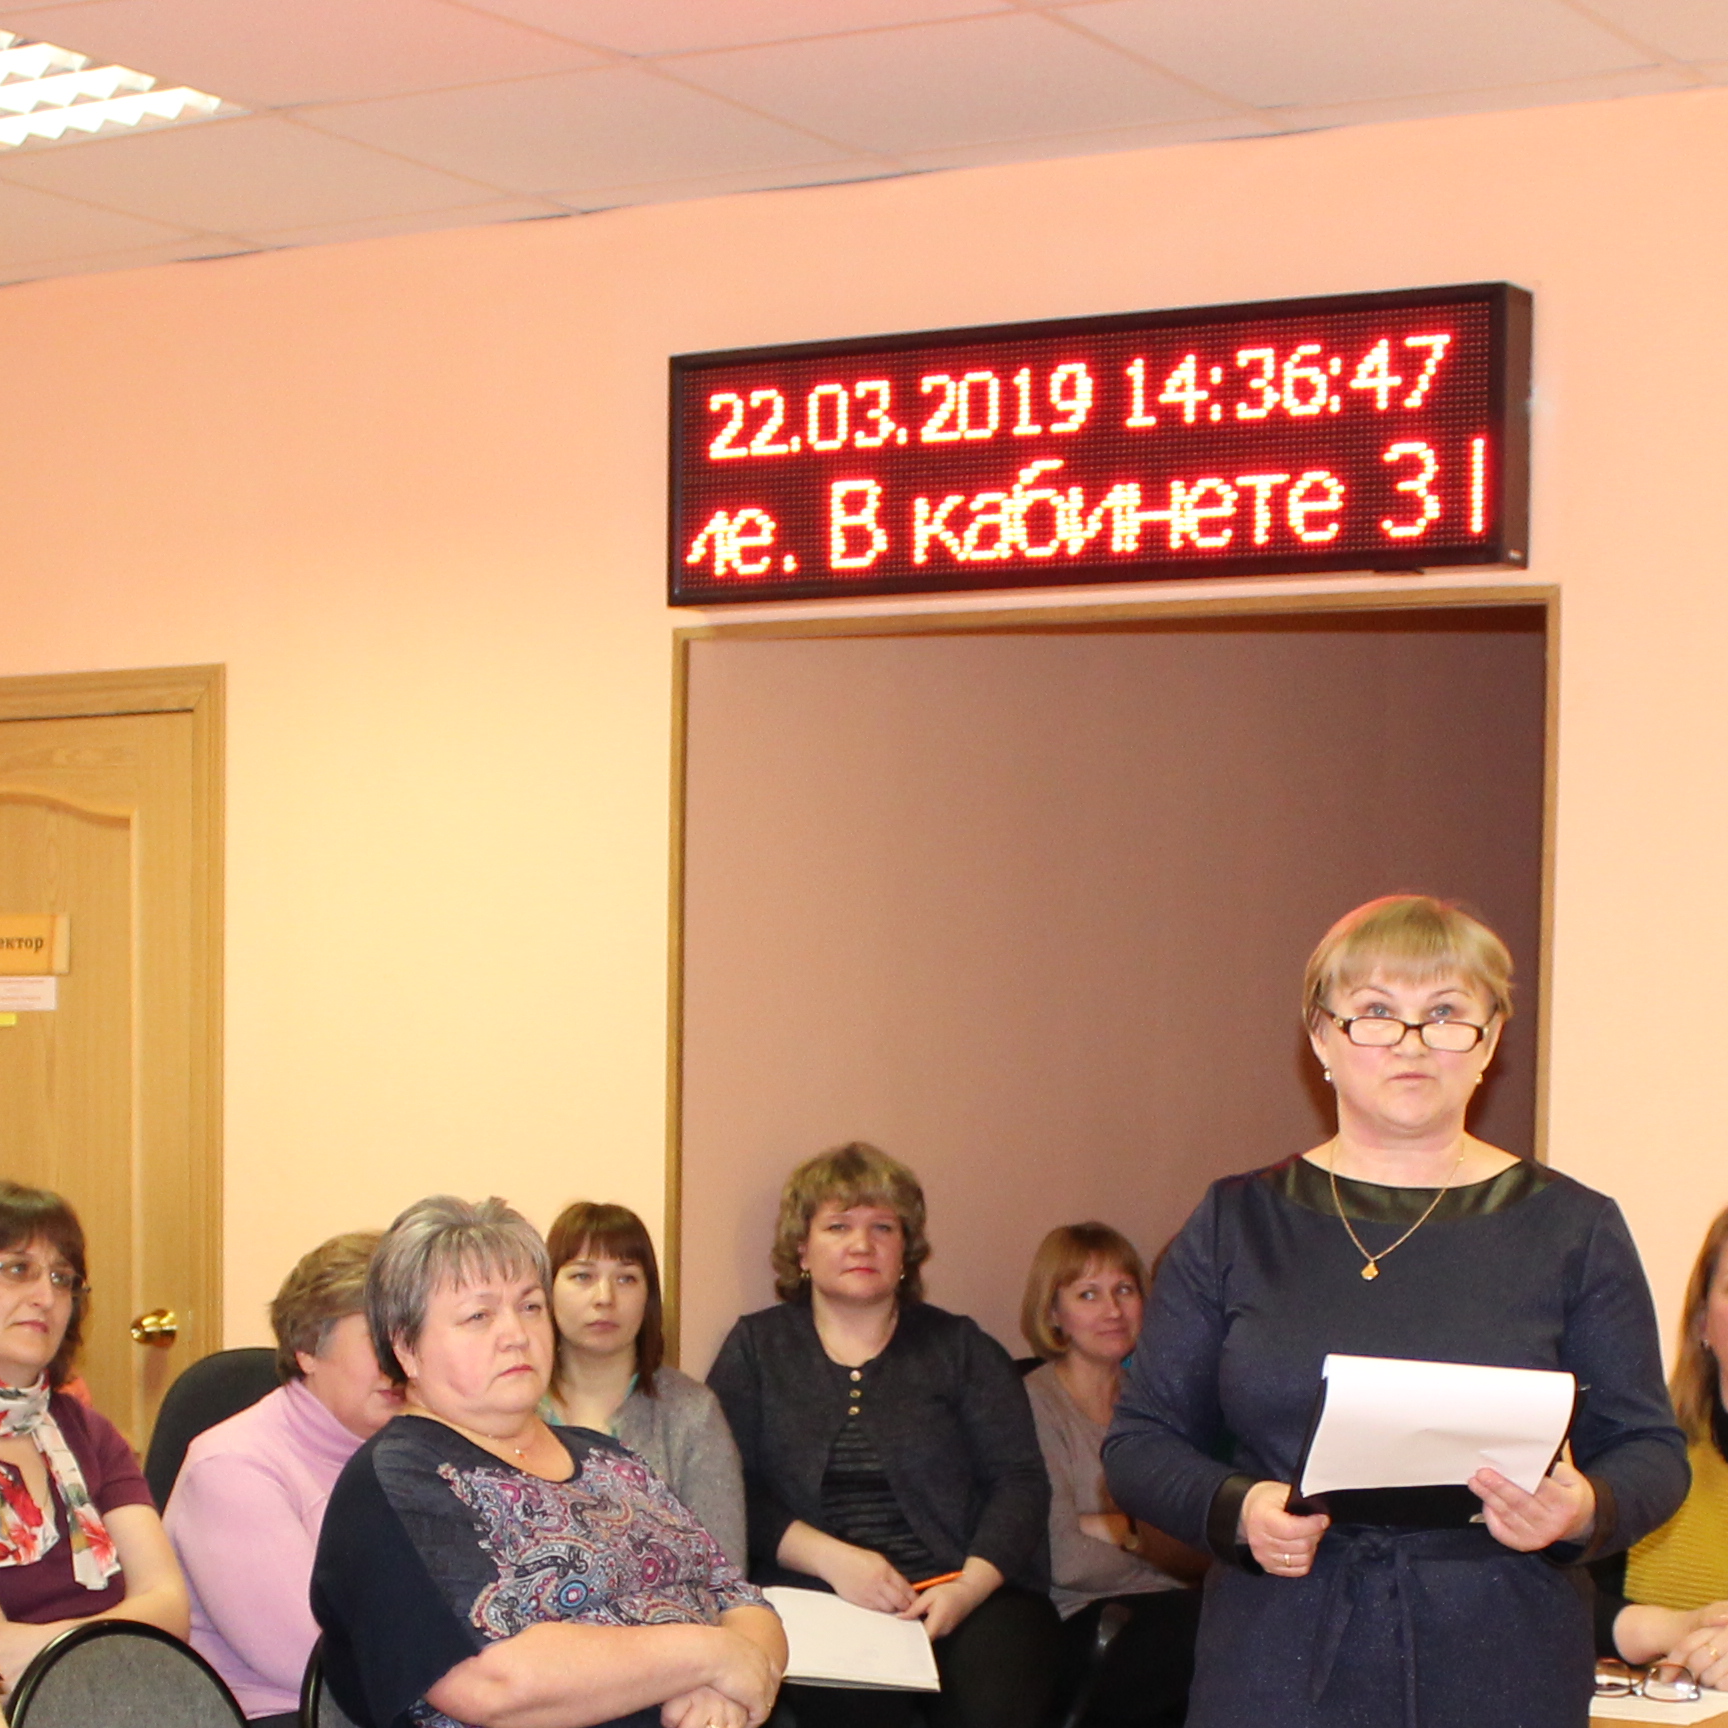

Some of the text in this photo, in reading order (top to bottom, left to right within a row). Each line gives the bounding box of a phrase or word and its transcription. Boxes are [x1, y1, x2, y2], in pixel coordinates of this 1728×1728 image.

[709, 334, 1451, 459] 22.03.2019 14:36:47
[829, 479, 888, 570] В
[913, 458, 1345, 565] кабинете
